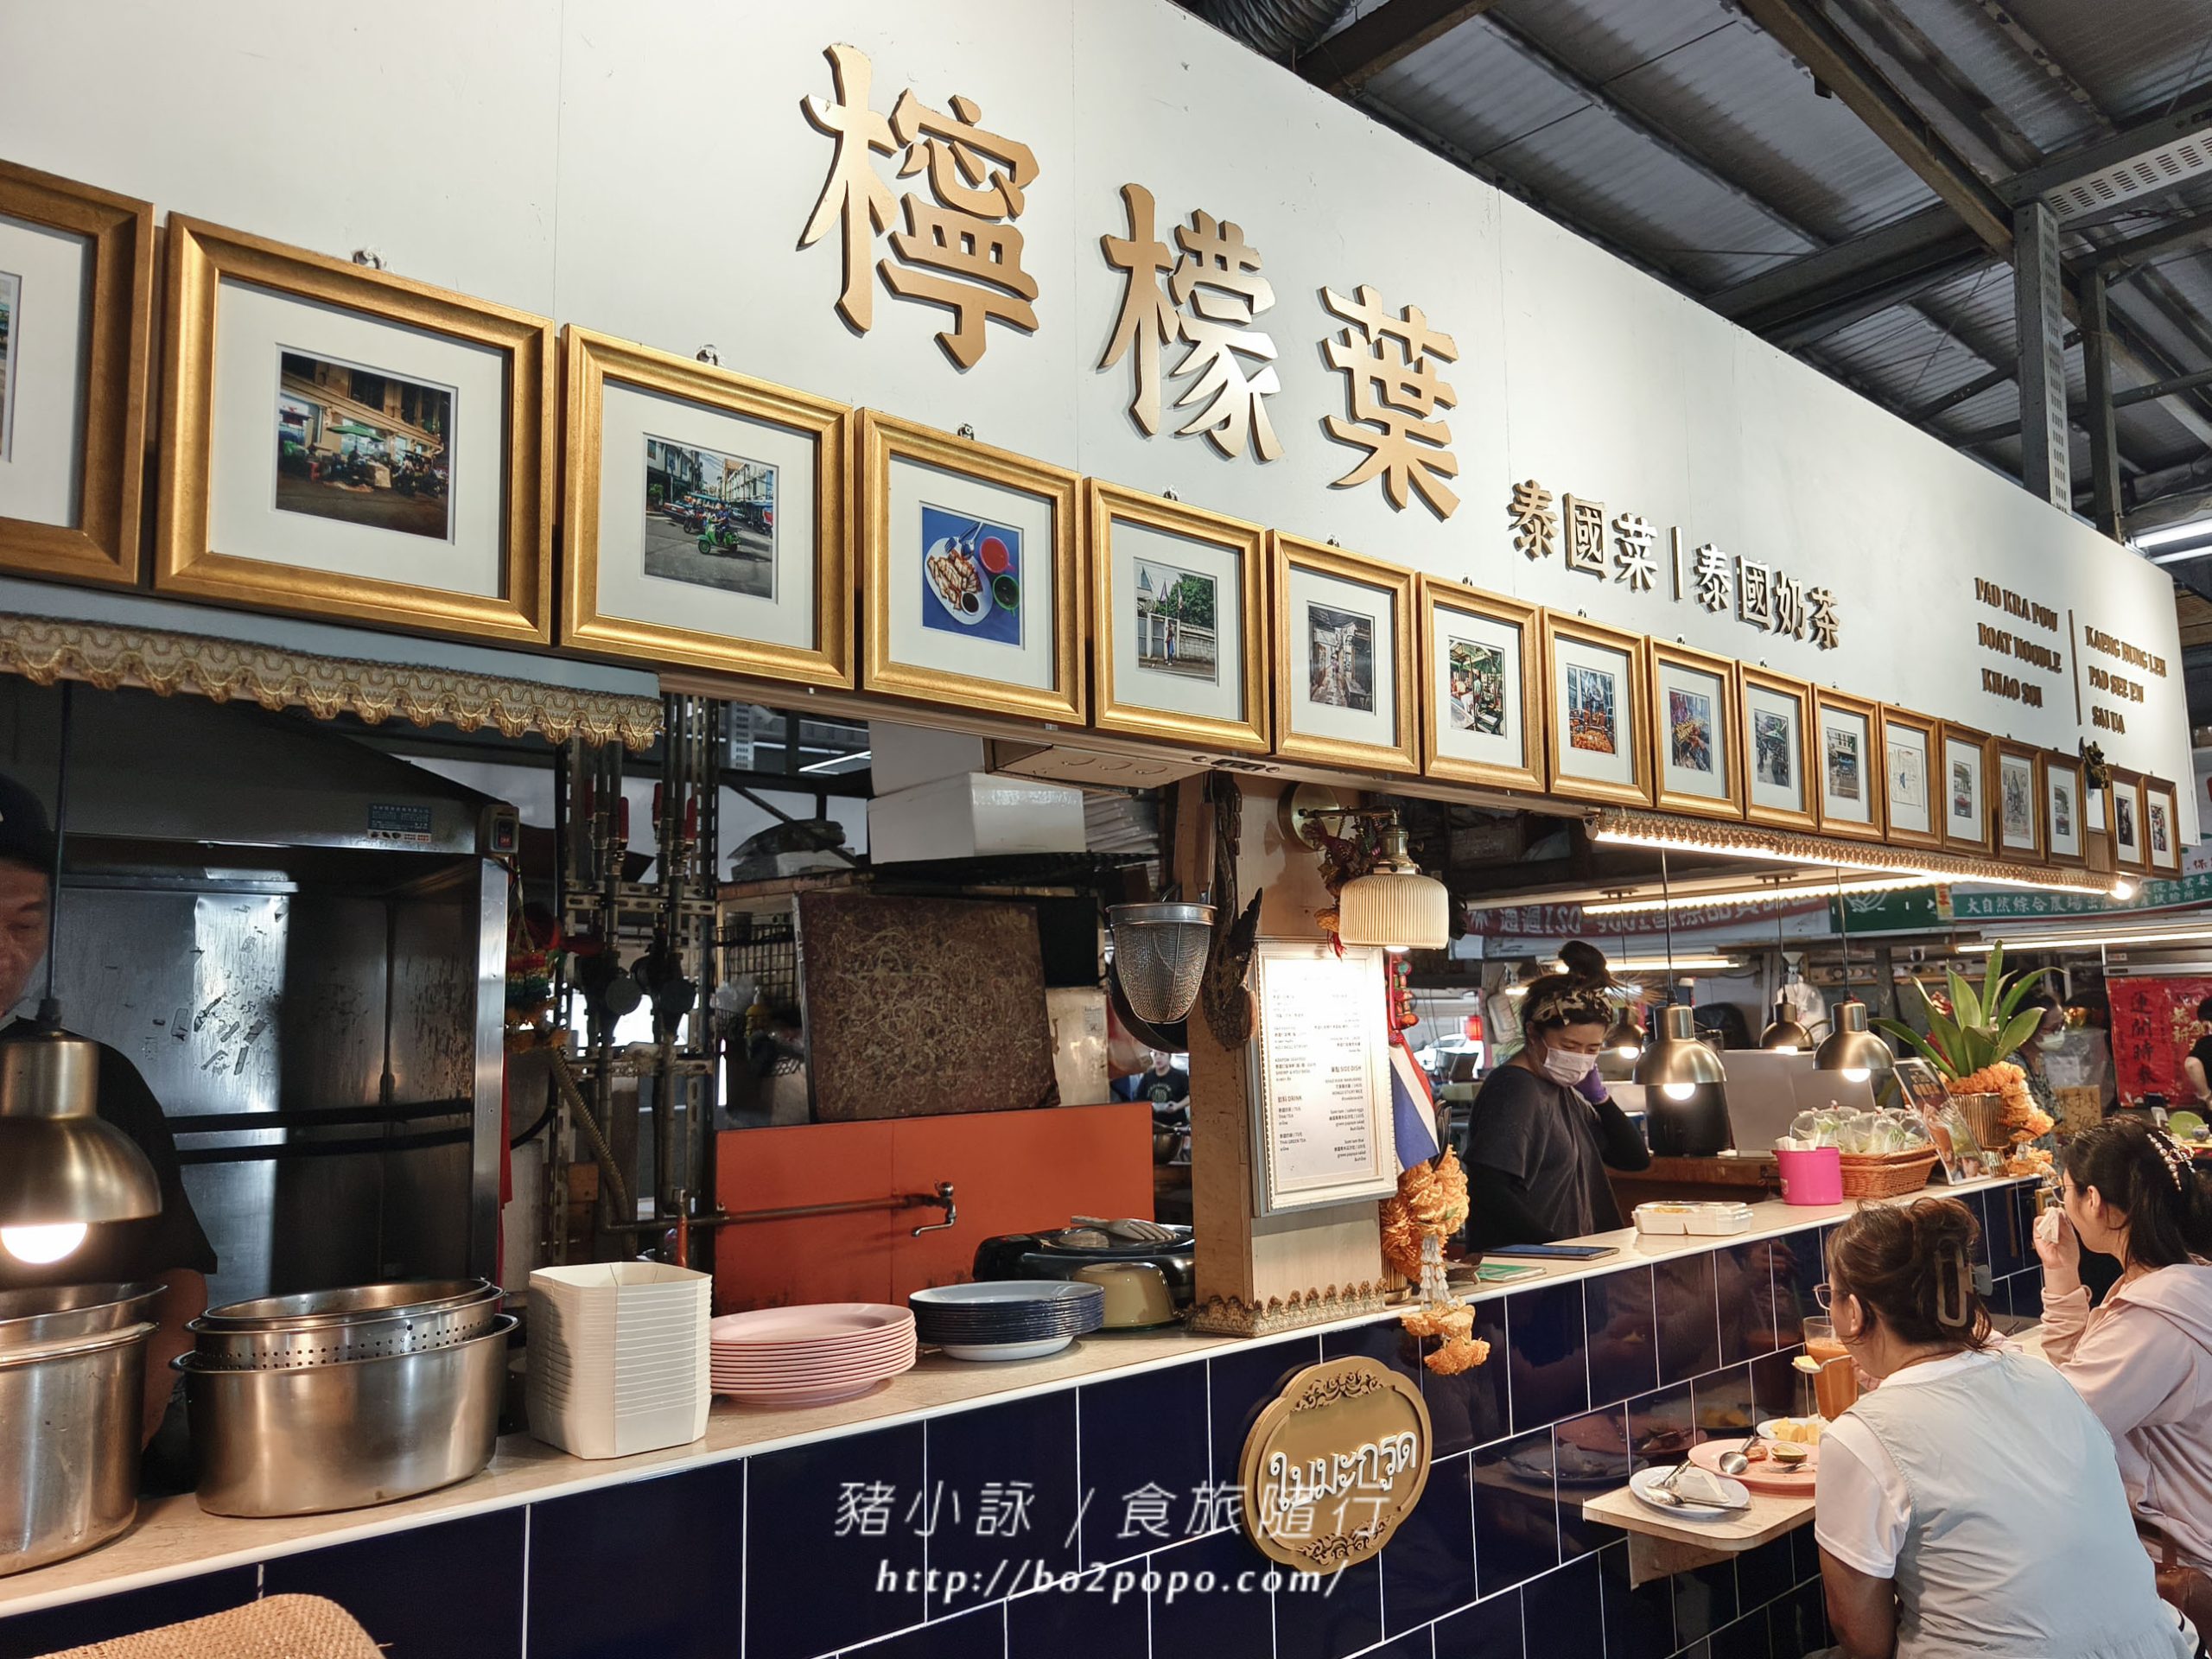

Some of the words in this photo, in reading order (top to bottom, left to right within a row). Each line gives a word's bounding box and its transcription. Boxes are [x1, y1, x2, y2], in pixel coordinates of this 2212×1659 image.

[796, 42, 1461, 523] 檸檬葉
[1507, 480, 1658, 592] 泰國菜
[1691, 543, 1840, 651] 泰國奶茶
[1974, 577, 2001, 608] PAD
[2002, 588, 2031, 621] KRA
[1977, 622, 2012, 656] BOAT
[2013, 636, 2063, 674] NOODLE
[1981, 667, 2021, 701] KHAO
[2088, 665, 2109, 690] PAD
[2092, 705, 2110, 730] SAI
[2110, 711, 2126, 734] UA
[1269, 1431, 1417, 1511] ใบมะกรูด
